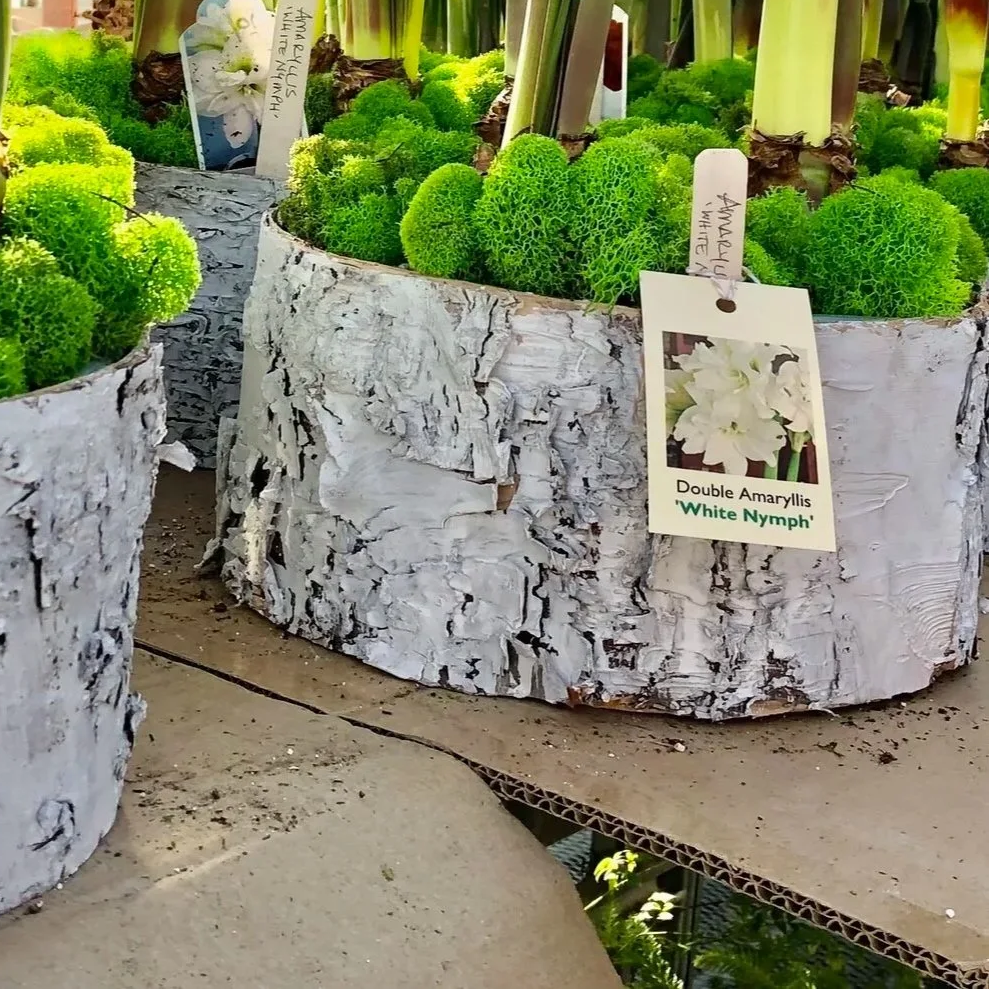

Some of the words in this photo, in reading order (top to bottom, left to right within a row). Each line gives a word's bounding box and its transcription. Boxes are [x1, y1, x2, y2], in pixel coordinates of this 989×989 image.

[676, 479, 734, 499] Double
[739, 487, 812, 509] Amaryllis
[675, 499, 737, 521] 'White
[743, 508, 814, 531] Nymph'
